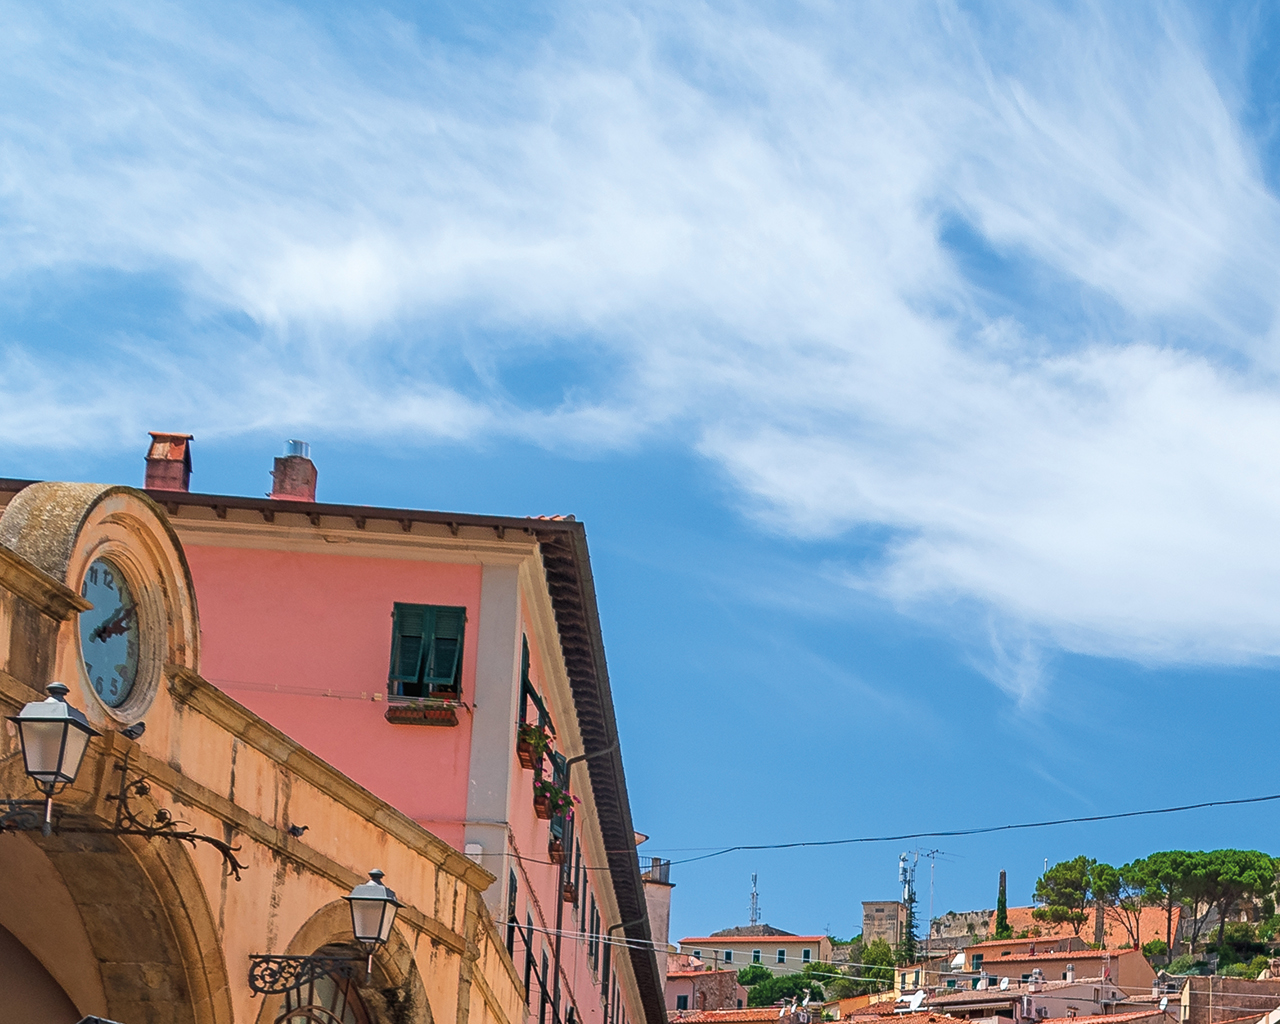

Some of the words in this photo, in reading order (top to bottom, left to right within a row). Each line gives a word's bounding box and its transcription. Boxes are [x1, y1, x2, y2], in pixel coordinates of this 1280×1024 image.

[89, 565, 99, 586] 11
[103, 568, 114, 591] 12
[95, 676, 103, 696] 6
[110, 678, 118, 697] 5
